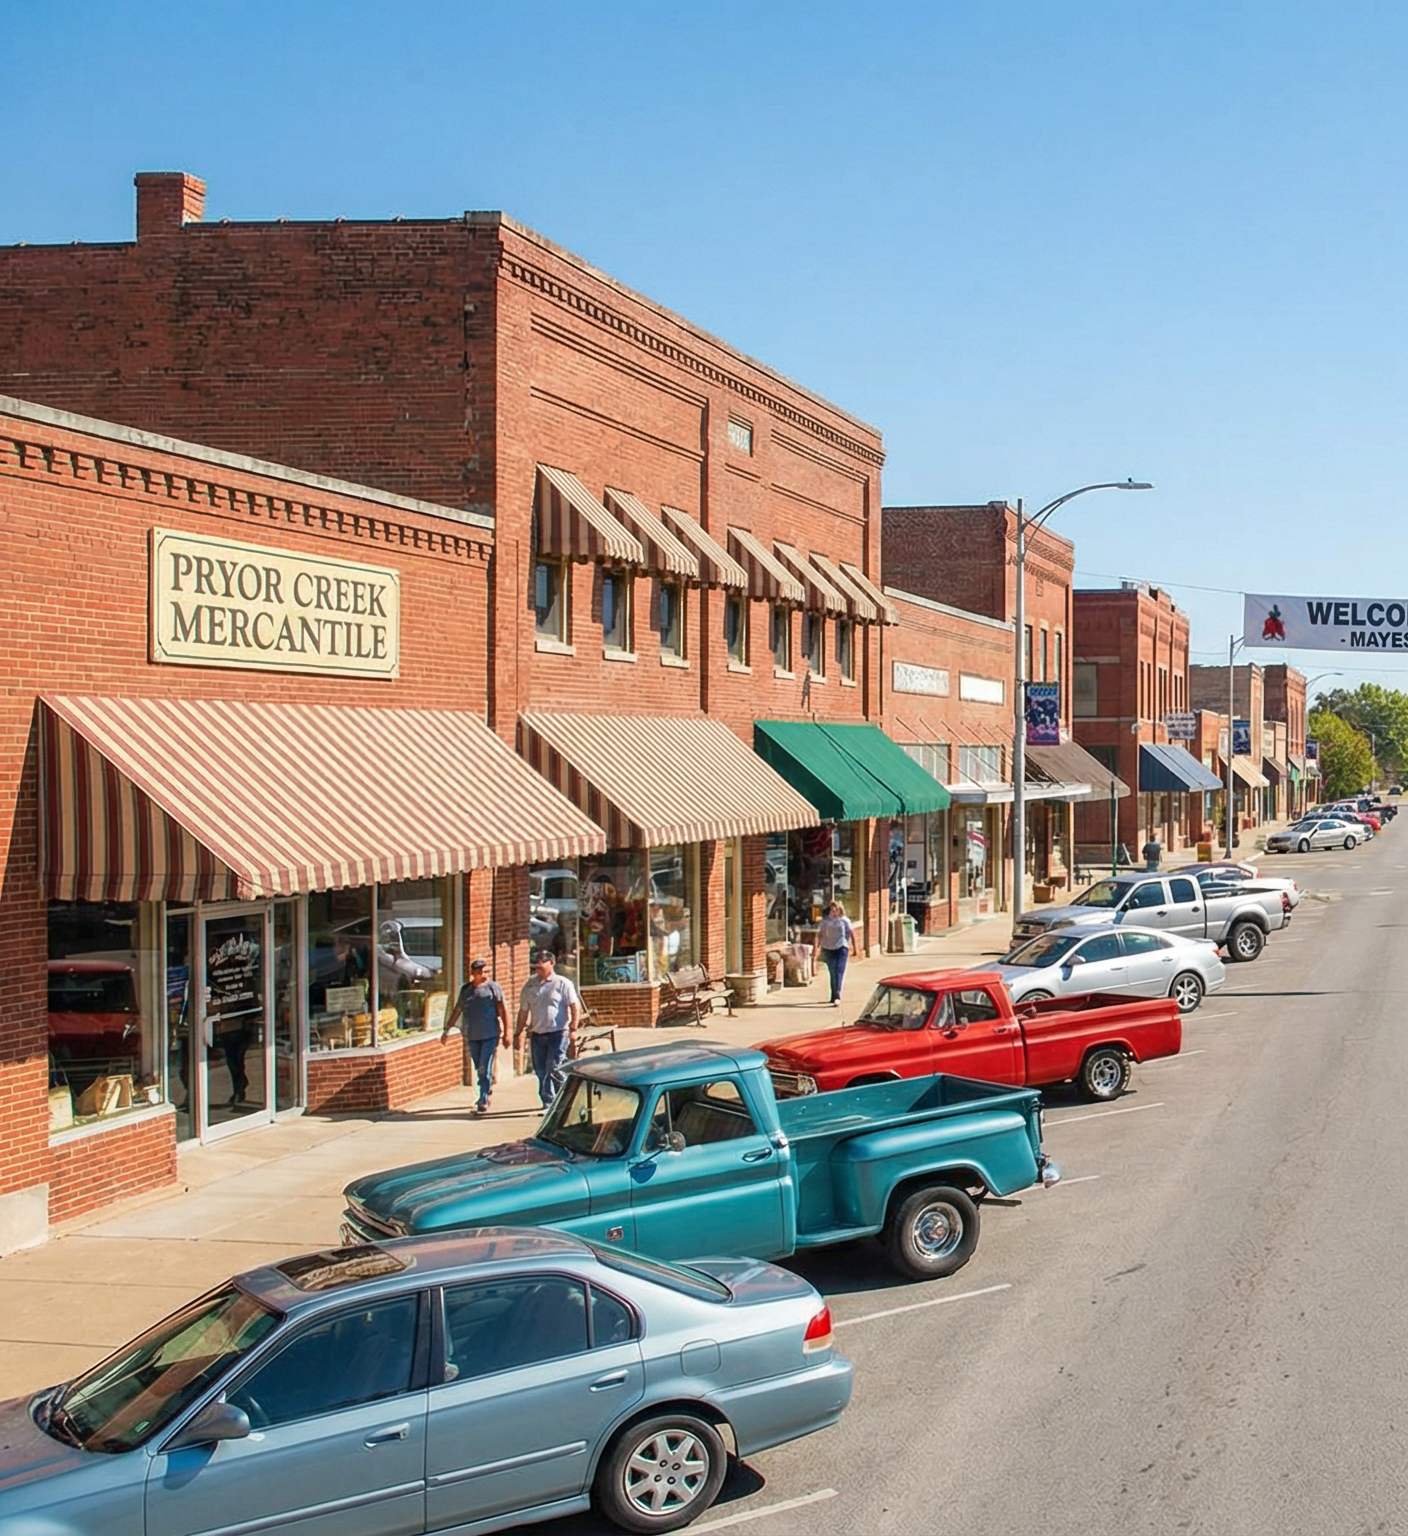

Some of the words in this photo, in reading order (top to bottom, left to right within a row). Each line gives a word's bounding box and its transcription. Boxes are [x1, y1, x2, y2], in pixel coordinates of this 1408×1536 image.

[170, 552, 284, 604] PRYOR
[293, 572, 387, 618] CREEK
[170, 601, 387, 660] MERCANTILE
